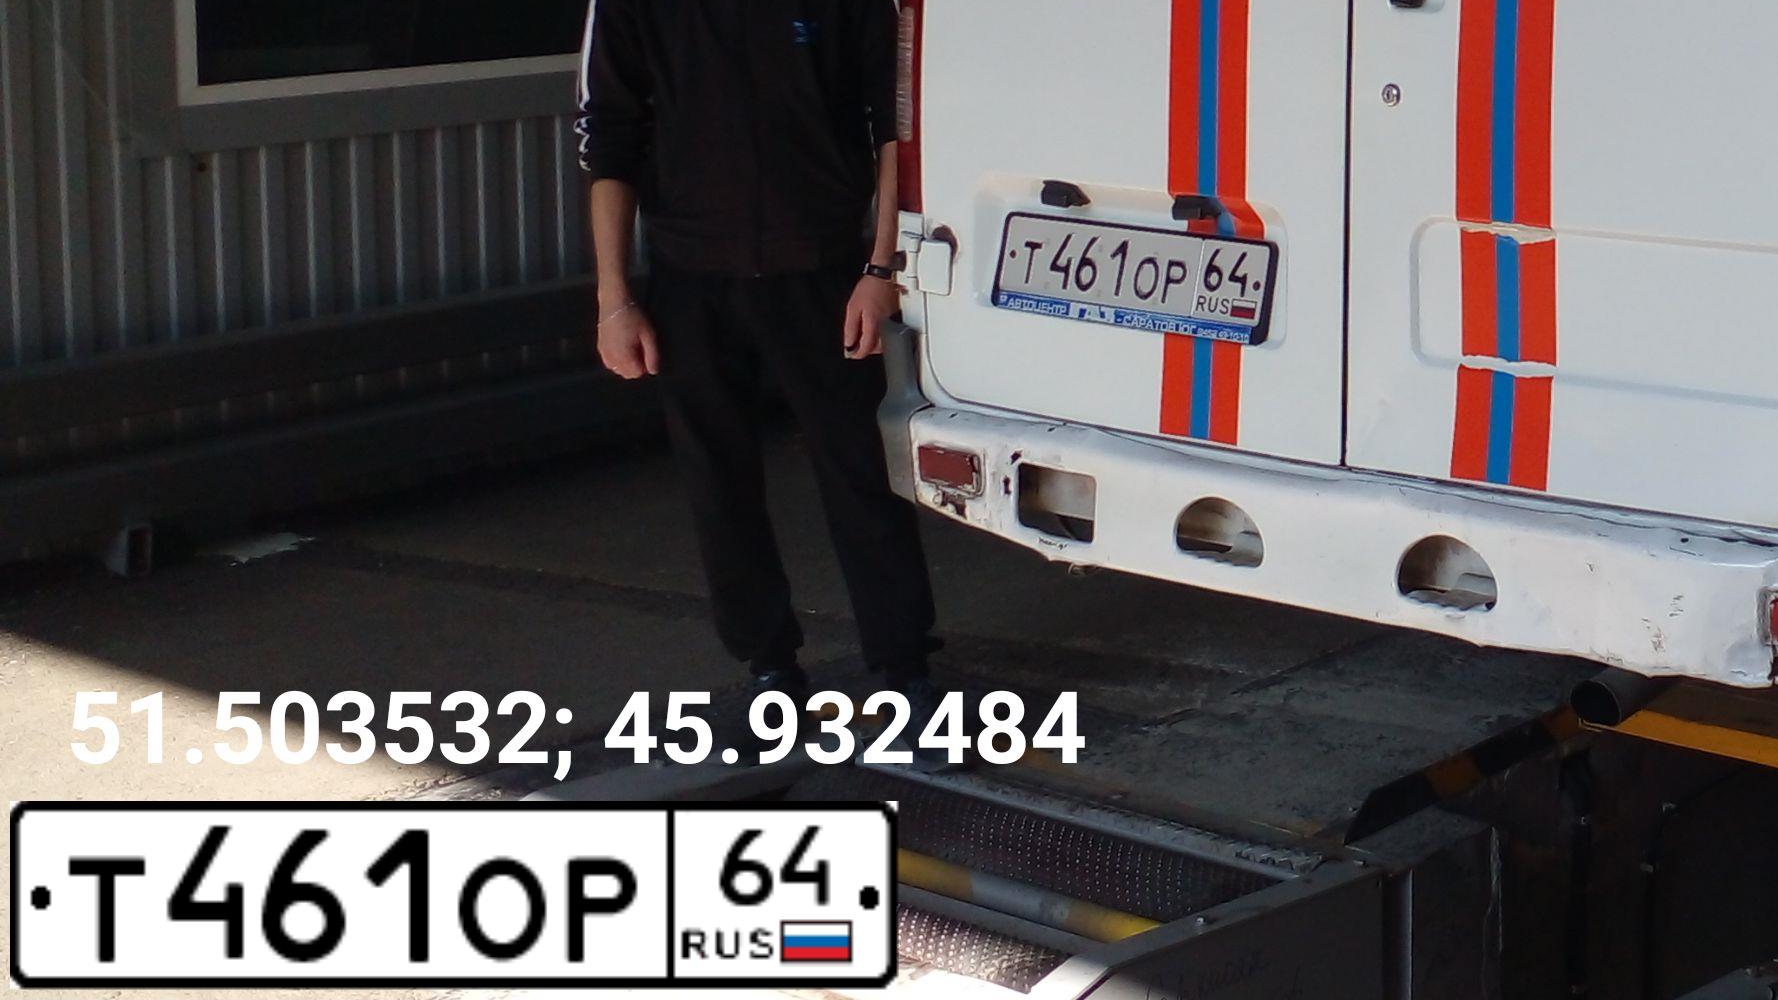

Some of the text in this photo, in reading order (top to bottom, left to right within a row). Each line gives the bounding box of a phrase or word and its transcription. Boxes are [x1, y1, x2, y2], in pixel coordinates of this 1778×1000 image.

[1023, 232, 1188, 304] Т461ОР
[1203, 247, 1248, 298] 64
[1195, 294, 1230, 316] RUS
